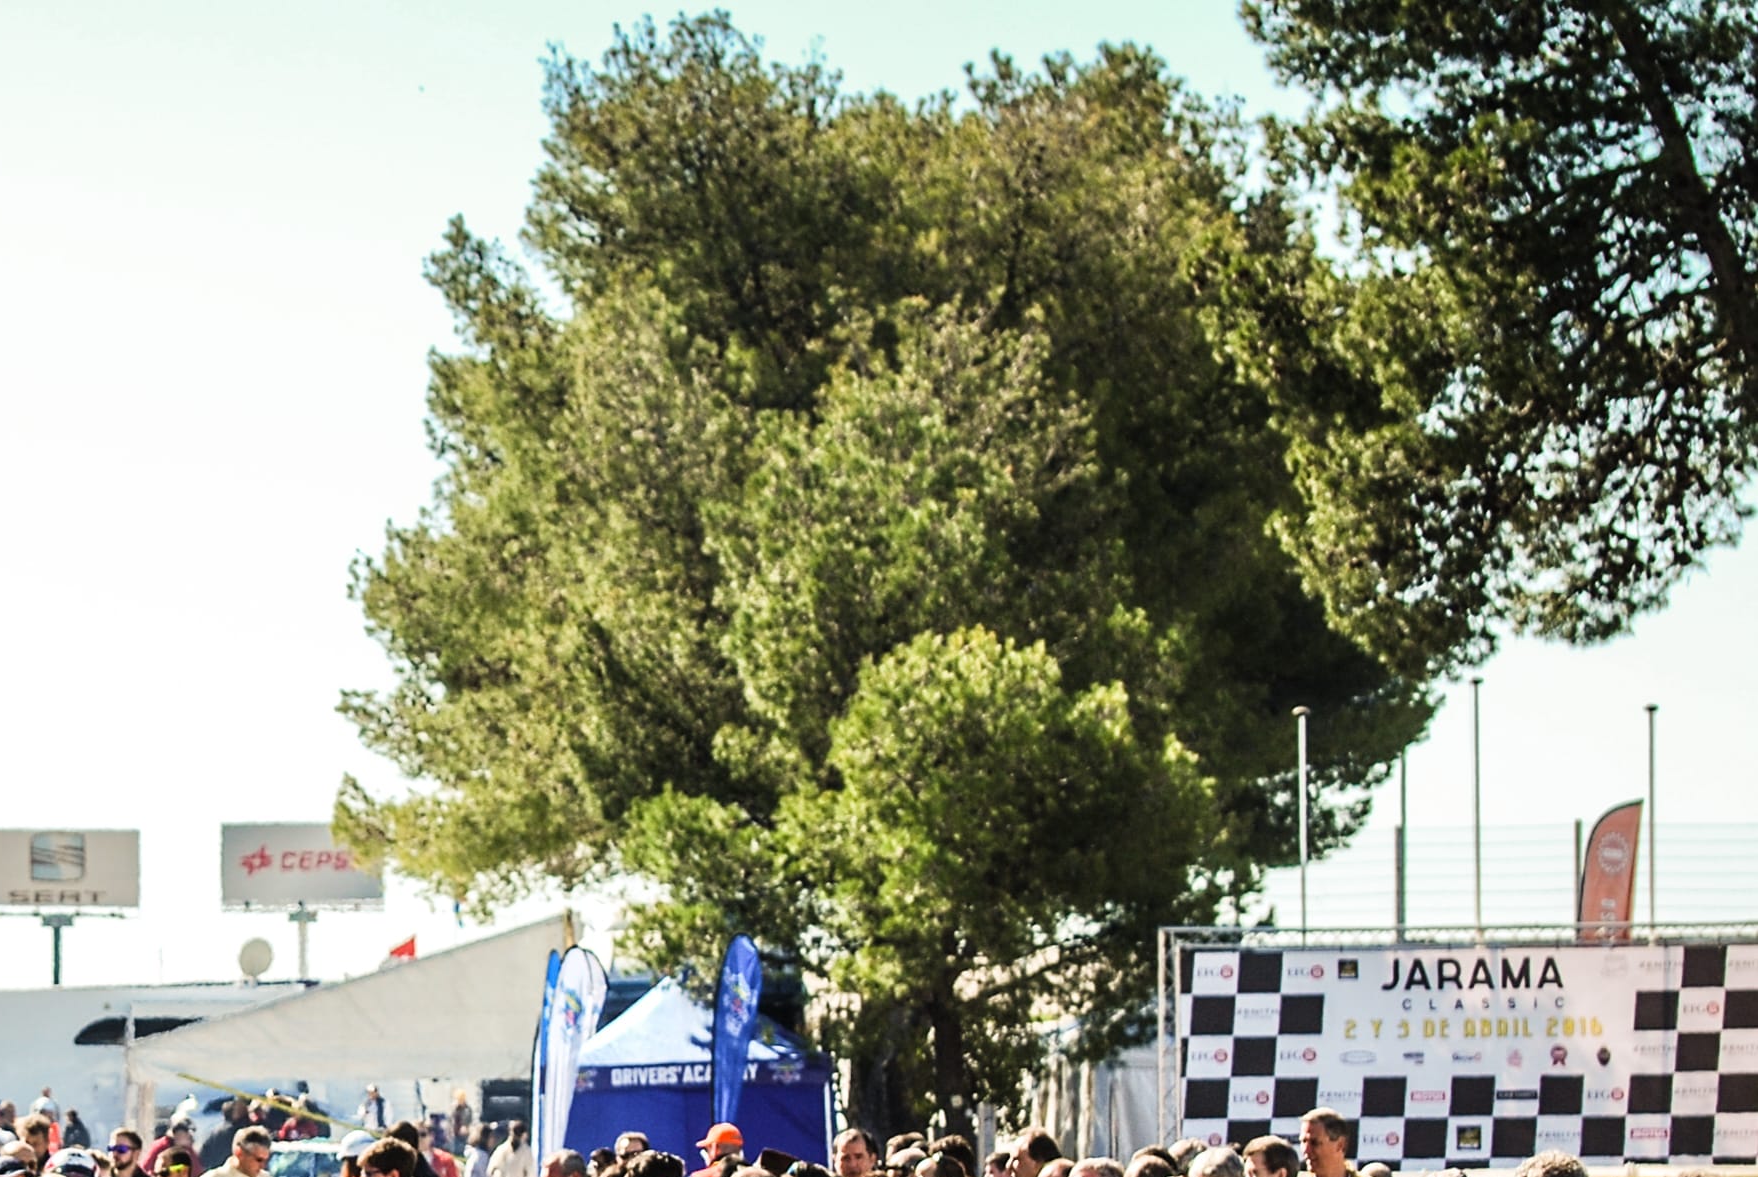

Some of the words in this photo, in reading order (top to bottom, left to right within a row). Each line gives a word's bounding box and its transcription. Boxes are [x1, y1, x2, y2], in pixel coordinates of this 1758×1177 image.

[281, 851, 353, 872] CEPS
[8, 890, 106, 904] SEAT
[1381, 957, 1564, 990] JARAMA
[1402, 997, 1565, 1010] CLASSIC
[1344, 1019, 1357, 1039] 2
[1370, 1019, 1383, 1039] Y
[1397, 1019, 1410, 1039] 3
[1423, 1018, 1449, 1038] DE
[1546, 1016, 1603, 1037] 2016
[682, 1063, 759, 1083] ACAY
